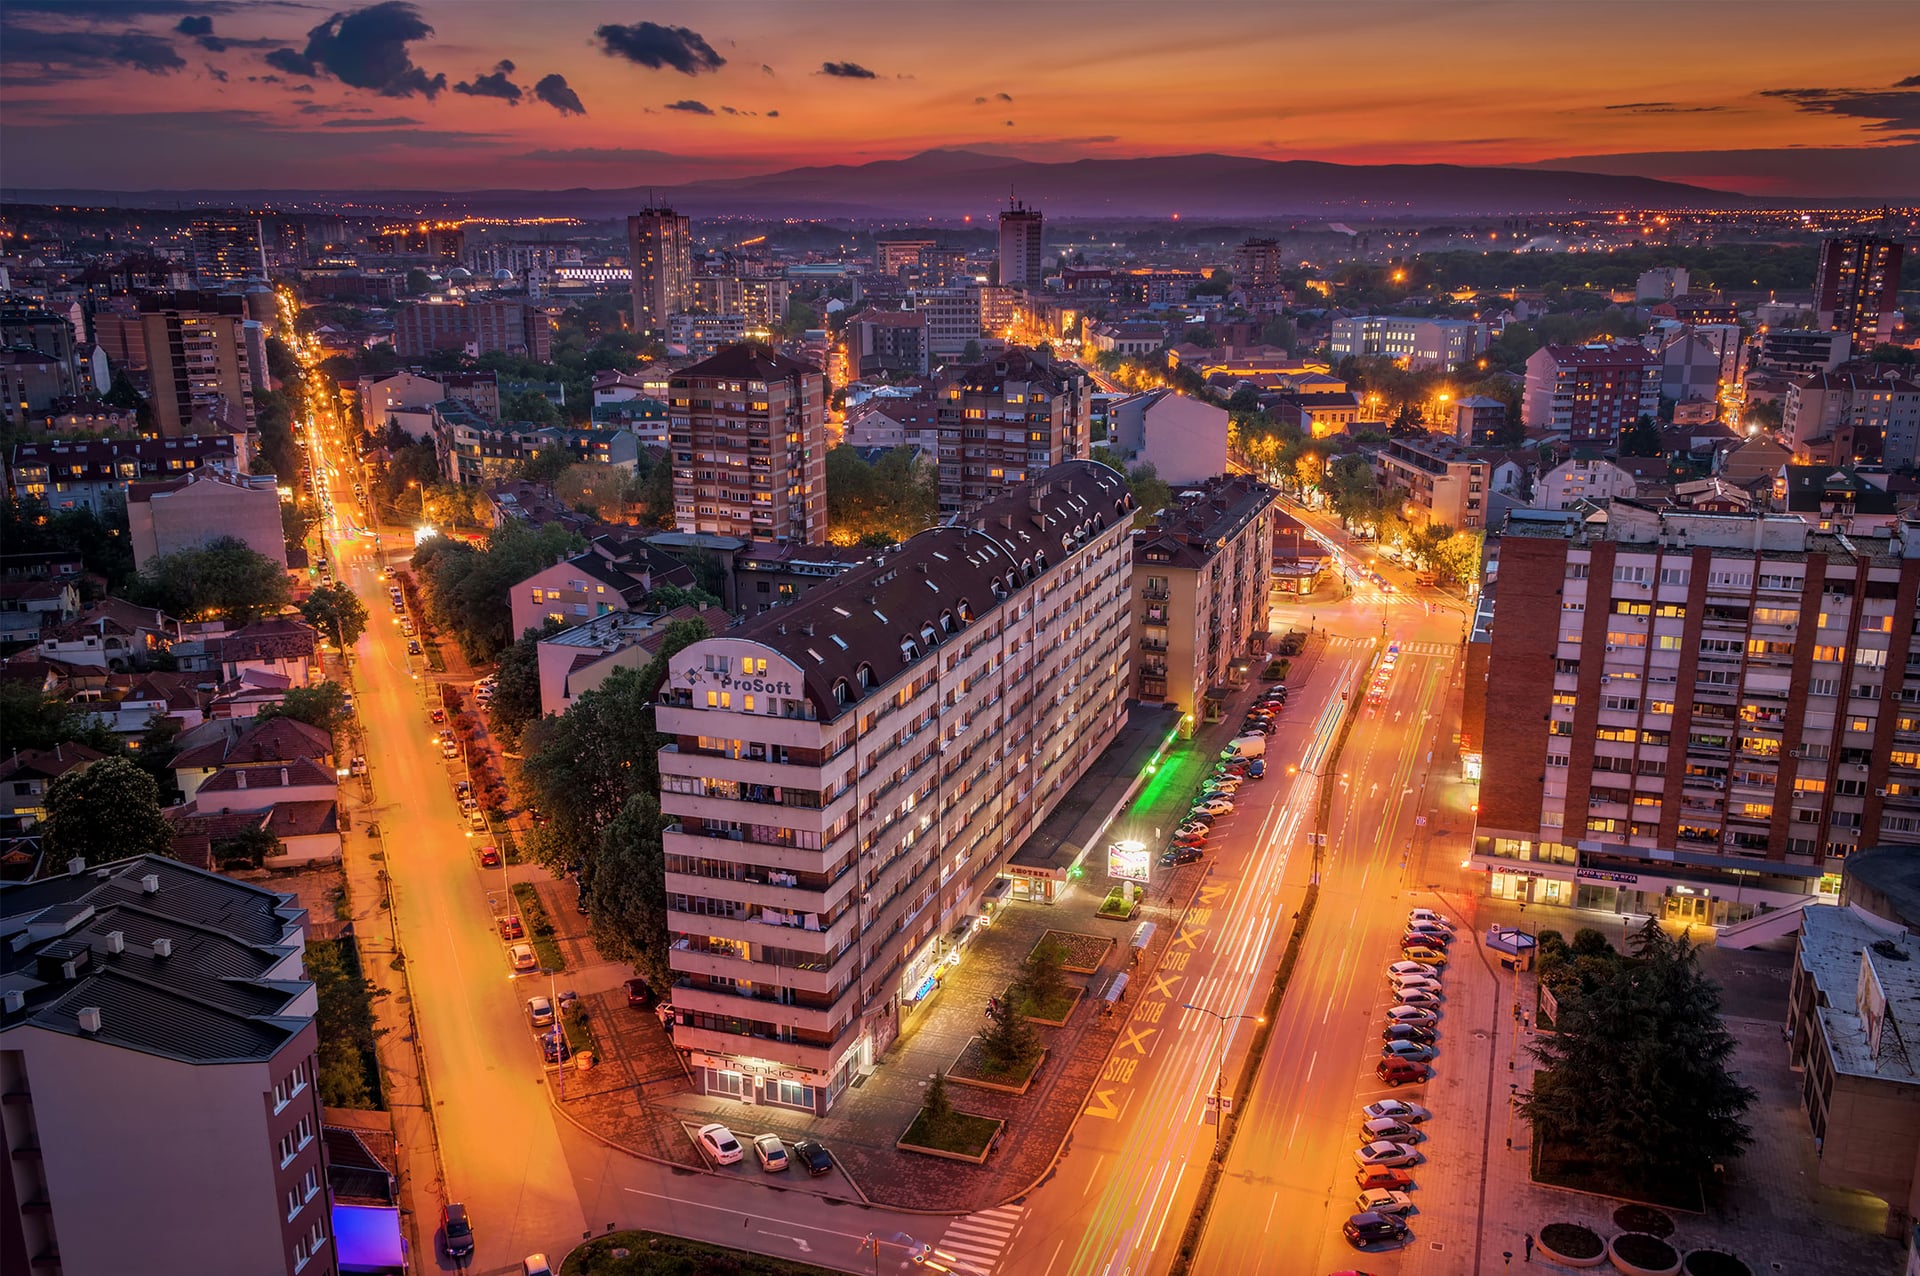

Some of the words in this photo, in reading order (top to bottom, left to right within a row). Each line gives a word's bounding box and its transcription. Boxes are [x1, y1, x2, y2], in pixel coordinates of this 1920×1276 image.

[721, 675, 791, 695] ProSoft
[1505, 867, 1529, 875] UniCredit
[1187, 907, 1212, 925] BUS
[1162, 951, 1191, 971] BUS
[1135, 1001, 1166, 1023] BUS
[719, 1058, 794, 1079] Trenkić
[1103, 1056, 1138, 1084] BUS
